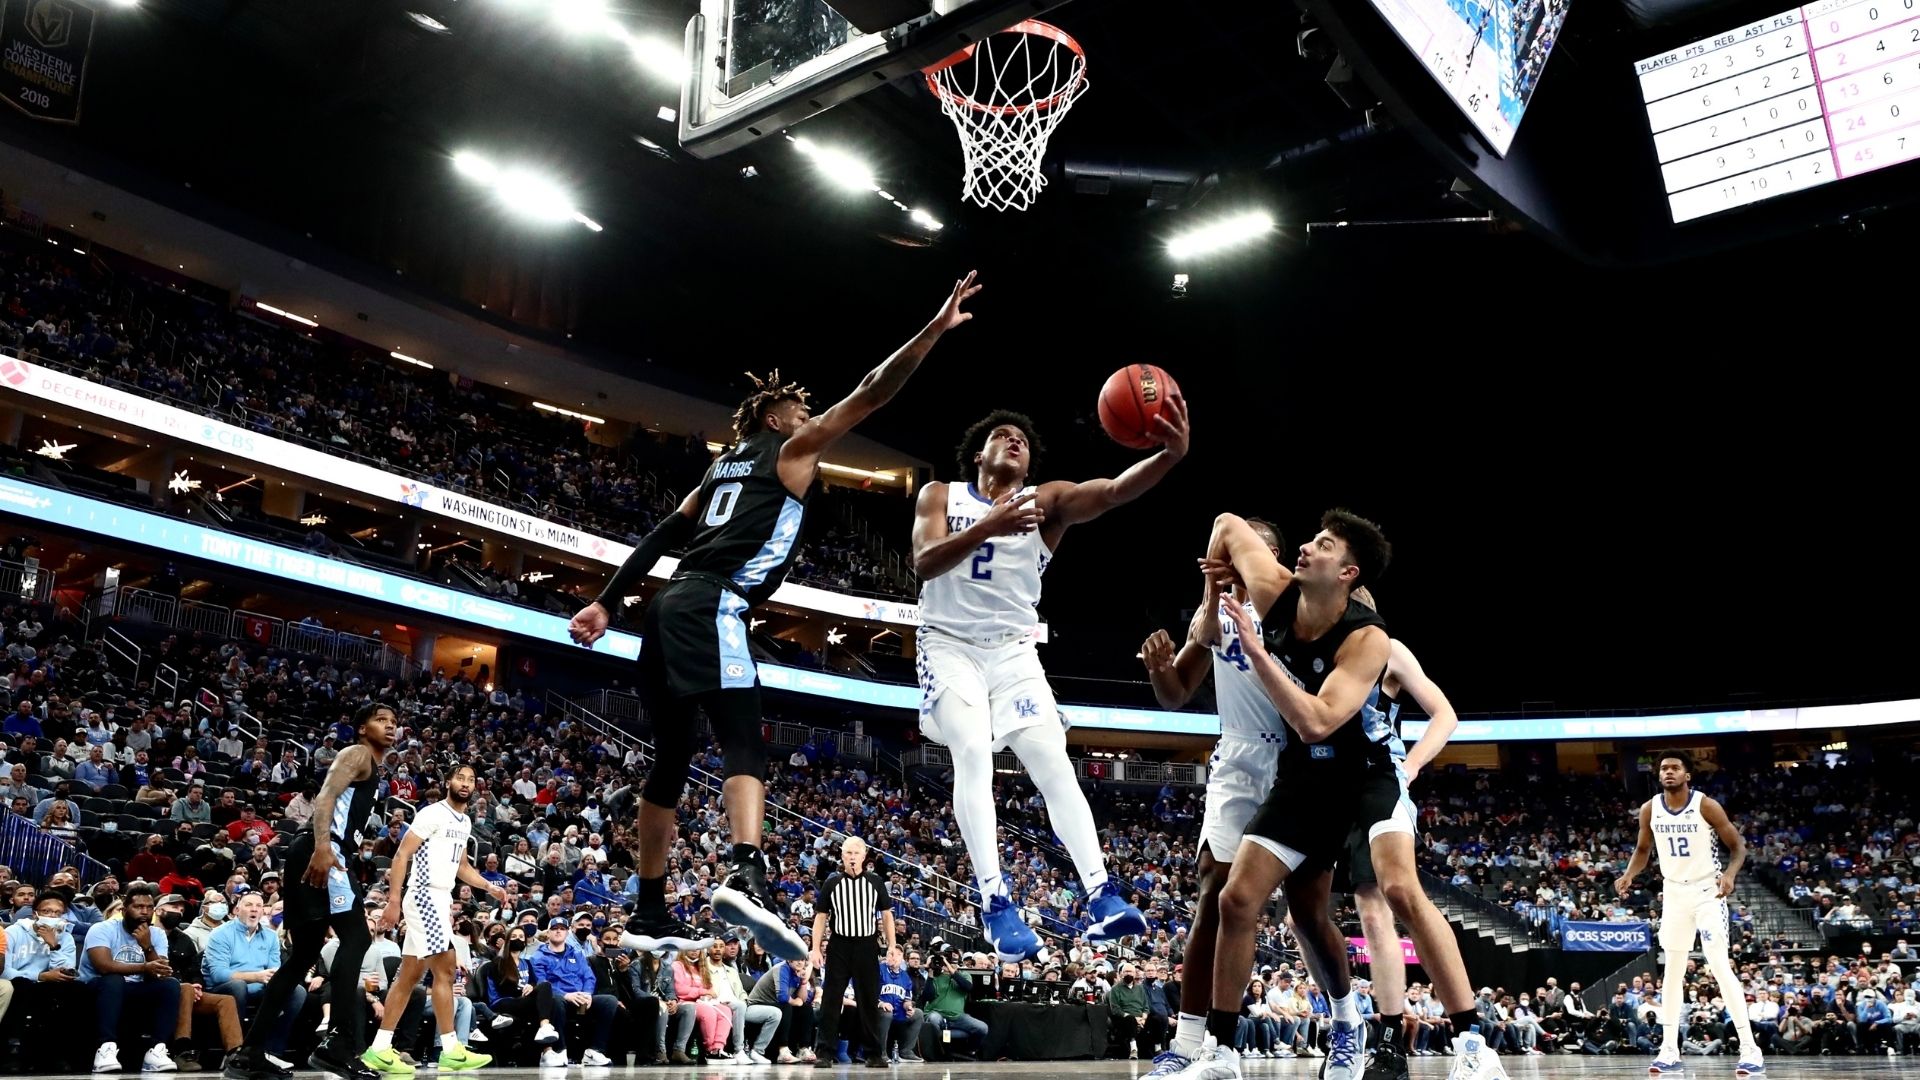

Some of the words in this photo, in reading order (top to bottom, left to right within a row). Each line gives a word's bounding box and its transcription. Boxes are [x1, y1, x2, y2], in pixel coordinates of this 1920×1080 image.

[1830, 21, 1839, 33] 0
[1869, 8, 1878, 20] 0
[13, 39, 72, 74] WESTERN
[1640, 53, 1678, 72] PLAYER
[1685, 44, 1705, 58] PTS
[1714, 34, 1735, 48] REB
[1745, 25, 1764, 38] AST
[1773, 15, 1793, 28] FLS
[1691, 64, 1708, 79] 22
[1726, 55, 1734, 67] 3
[1756, 45, 1764, 57] 5
[1784, 36, 1793, 48] 2
[1838, 53, 1847, 66] 2
[1876, 40, 1885, 52] 4
[1911, 30, 1920, 42] 2
[4, 48, 77, 86] CONFERENCE
[1884, 73, 1893, 85] 6
[20, 87, 50, 108] 2018
[1468, 93, 1481, 112] 46
[1702, 94, 1711, 106] 6
[1735, 86, 1740, 97] 1
[1763, 76, 1771, 88] 2
[1791, 67, 1800, 79] 2
[1710, 126, 1718, 138] 2
[1743, 116, 1748, 127] 1
[1769, 108, 1778, 119] 0
[1798, 99, 1807, 110] 0
[1847, 117, 1866, 130] 24
[1891, 105, 1900, 117] 0
[1717, 156, 1725, 168] 9
[1747, 147, 1756, 159] 3
[1780, 138, 1785, 150] 1
[1805, 130, 1814, 142] 0
[1855, 149, 1874, 162] 45
[1898, 138, 1906, 150] 7
[1723, 186, 1737, 199] 11
[1750, 177, 1767, 191] 10
[1787, 170, 1793, 181] 1
[1813, 162, 1822, 174] 2
[41, 379, 128, 413] DECEMBER
[217, 429, 255, 452] CBS
[713, 460, 755, 479] HARRIS
[443, 495, 517, 530] WASHINGTON
[520, 519, 532, 535] ST
[547, 528, 579, 548] MIAMI
[705, 482, 743, 527] 0
[971, 542, 995, 580] 2
[254, 622, 263, 637] 5
[1093, 765, 1100, 775] 3
[1655, 823, 1699, 833] KENTUCKY
[1668, 837, 1690, 857] 12
[1575, 931, 1599, 942] CBS
[1600, 931, 1646, 942] SPORTS
